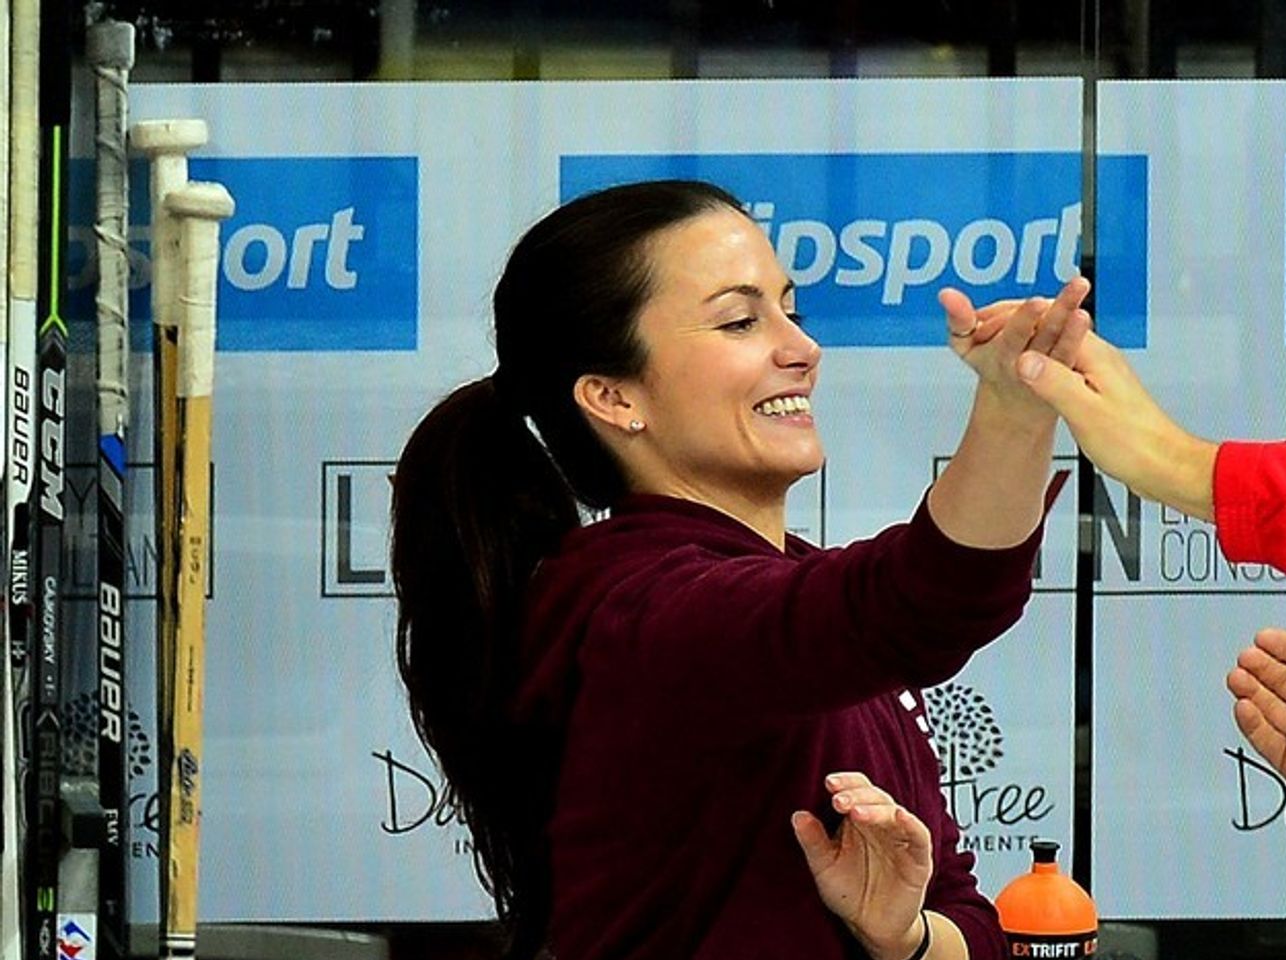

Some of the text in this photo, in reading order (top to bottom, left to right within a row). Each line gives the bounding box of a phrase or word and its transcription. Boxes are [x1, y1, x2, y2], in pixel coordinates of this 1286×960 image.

[40, 367, 66, 521] CCM
[12, 550, 29, 605] MIKUS
[1012, 942, 1080, 958] EXTRIFIT
